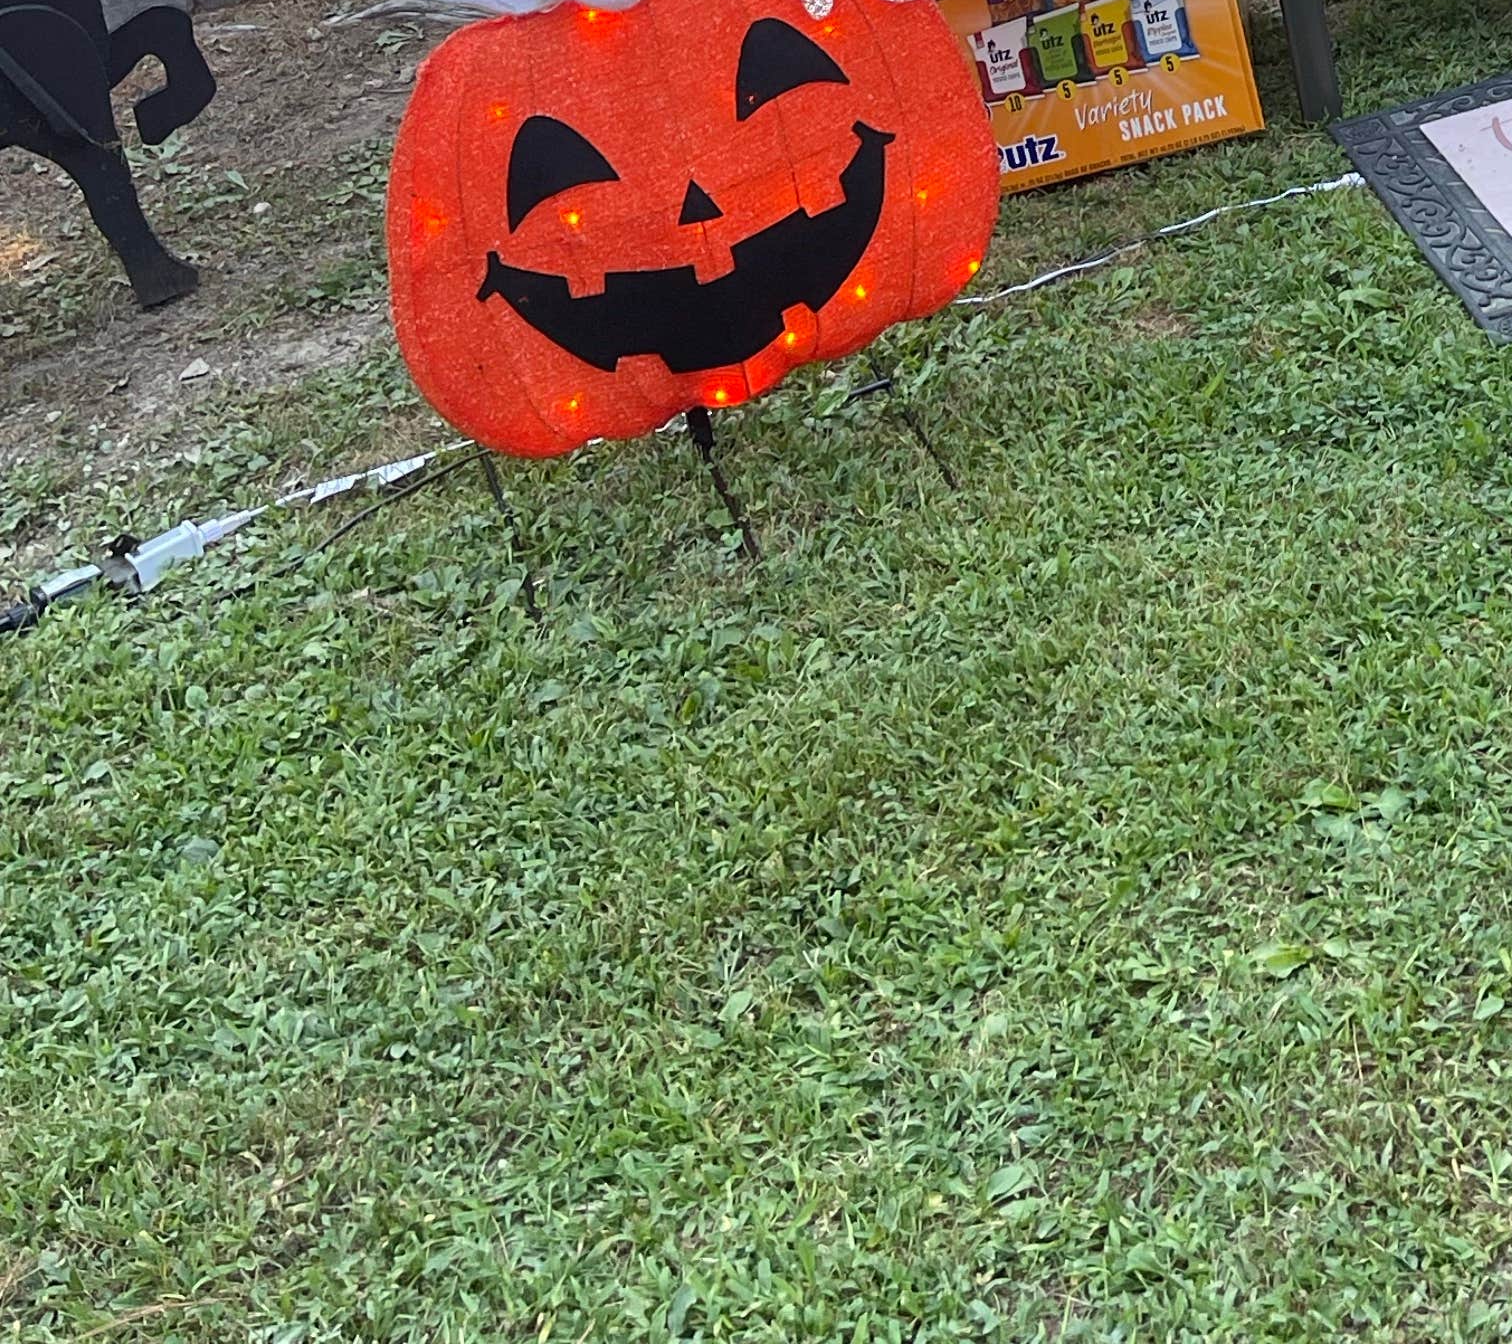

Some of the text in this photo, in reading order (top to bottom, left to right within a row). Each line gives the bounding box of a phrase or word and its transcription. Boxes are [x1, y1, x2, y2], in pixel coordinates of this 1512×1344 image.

[1146, 9, 1169, 24] utz
[1093, 22, 1116, 37] utz
[1041, 36, 1065, 50] utz
[990, 49, 1014, 64] utz
[1164, 55, 1175, 72] 5
[1113, 69, 1123, 86] 5
[1062, 82, 1072, 99] 5
[1008, 95, 1022, 113] 10
[1073, 88, 1153, 130] Variety
[1118, 94, 1228, 142] SNACK PACK
[1005, 135, 1061, 170] utz
